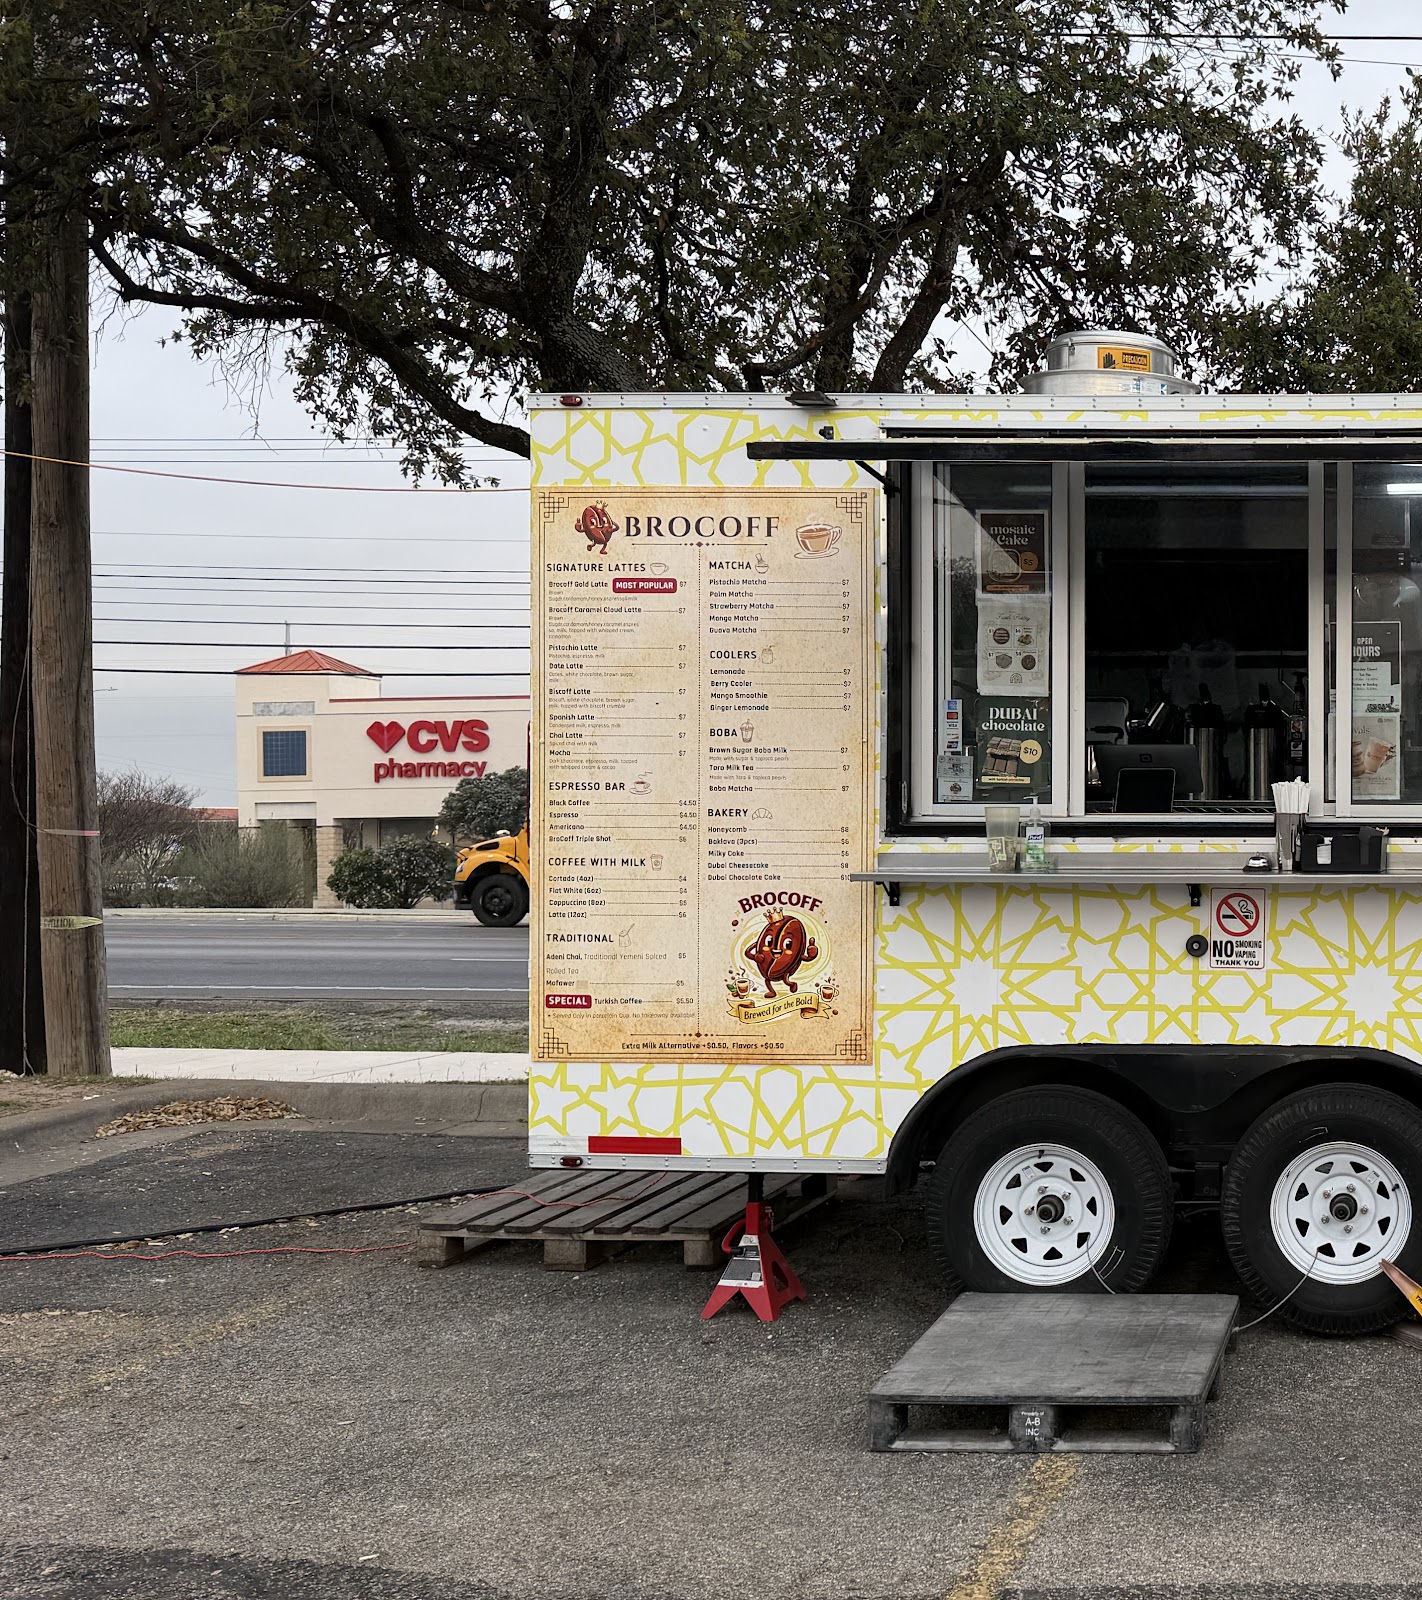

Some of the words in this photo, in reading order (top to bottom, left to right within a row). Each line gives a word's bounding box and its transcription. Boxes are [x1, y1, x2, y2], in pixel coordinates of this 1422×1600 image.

[624, 516, 780, 538] BROCOFF
[990, 524, 1036, 534] mosaic
[996, 534, 1028, 545] Cake
[546, 563, 603, 572] SIGNATURE
[608, 563, 646, 572] LATTES
[709, 561, 752, 570] MATCHA
[709, 651, 757, 659] COOLERS
[989, 708, 1038, 720] DUBAI
[982, 720, 1044, 731] chocolate
[406, 719, 490, 753] CVS
[709, 728, 738, 737] BOBA
[1023, 747, 1038, 756] $10
[374, 758, 487, 783] pharmacy
[549, 782, 600, 791] ESPRESSO
[605, 782, 626, 791] BAR
[707, 808, 748, 817] BAKERY
[548, 858, 586, 866] COFFEE
[590, 858, 616, 866] WITH
[621, 858, 646, 866] MILK
[738, 892, 823, 913] BROCOFF
[546, 934, 614, 943] TRADITIONAL
[1235, 940, 1262, 948] SMOKING
[1212, 940, 1234, 958] NO
[1235, 950, 1256, 958] VAPING
[548, 996, 588, 1005] SPECIAL
[744, 1010, 771, 1020] Brewed
[772, 1004, 782, 1016] for
[784, 1000, 794, 1010] the
[795, 996, 813, 1006] Bold
[1025, 1417, 1040, 1426] A-B
[1026, 1428, 1040, 1436] INC
